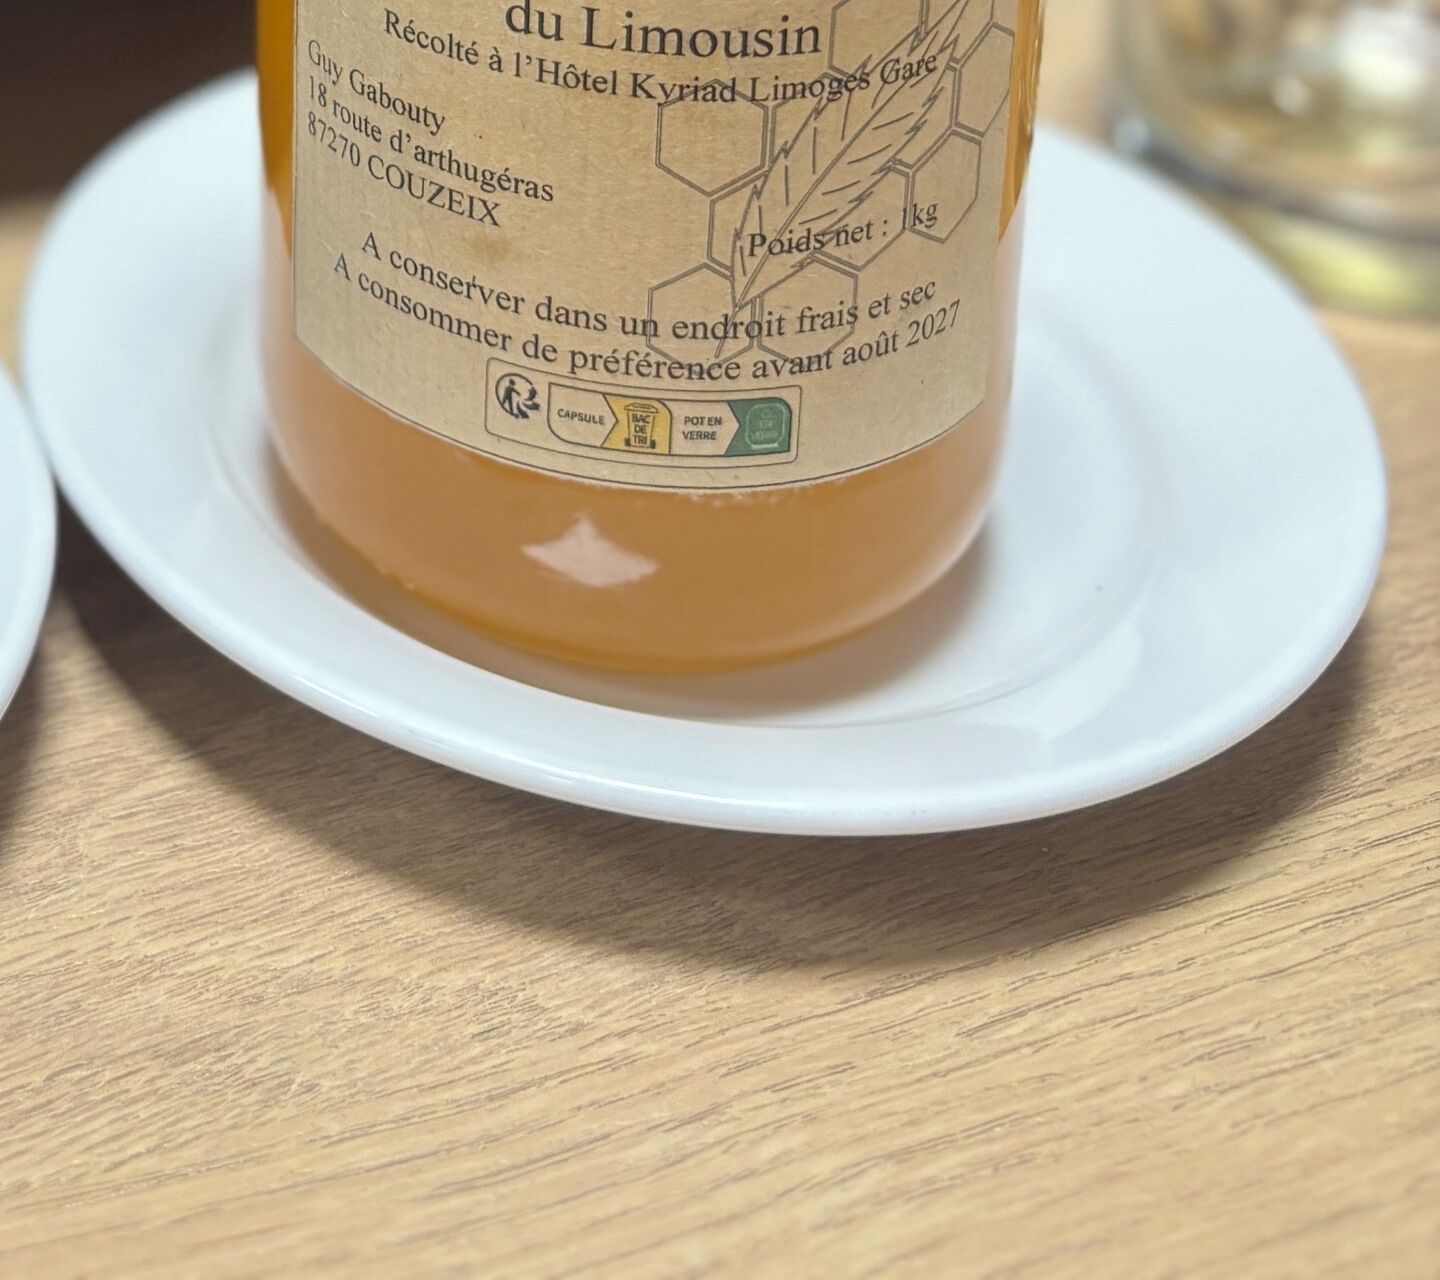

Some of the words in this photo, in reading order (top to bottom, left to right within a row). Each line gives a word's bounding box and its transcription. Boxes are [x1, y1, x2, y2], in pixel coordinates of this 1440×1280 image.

[581, 6, 821, 59] Limousin
[384, 8, 479, 66] Récolté
[488, 46, 504, 73] à
[514, 52, 617, 96] l'Hôtel
[631, 71, 737, 104] Kyriad
[749, 71, 871, 102] Limoges
[879, 54, 937, 85] Gare
[308, 40, 343, 86] Guy
[349, 69, 446, 136] Gabouty
[309, 76, 328, 107] 18
[333, 99, 382, 143] route
[308, 111, 361, 168] 87270
[368, 154, 501, 227] COUZEIX
[748, 228, 824, 257] Poids
[835, 221, 874, 247] net
[361, 231, 382, 260] A
[389, 250, 525, 315] conserver
[535, 295, 608, 331] dans
[619, 314, 659, 338] un
[671, 310, 786, 340] endroit
[795, 301, 858, 334] frais
[868, 293, 892, 319] et
[899, 280, 936, 310] sec
[334, 252, 351, 281] A
[358, 272, 512, 352] consommer
[522, 333, 558, 363] de
[567, 348, 741, 380] préférence
[751, 347, 833, 380] avant
[842, 330, 899, 366] août
[906, 298, 961, 348] 2027
[557, 408, 606, 426] CAPSULE
[631, 413, 650, 425] BAC
[634, 425, 647, 435] DE
[682, 430, 717, 441] VERRE
[684, 416, 706, 426] POT
[707, 416, 723, 426] EN
[632, 435, 648, 446] TRI
